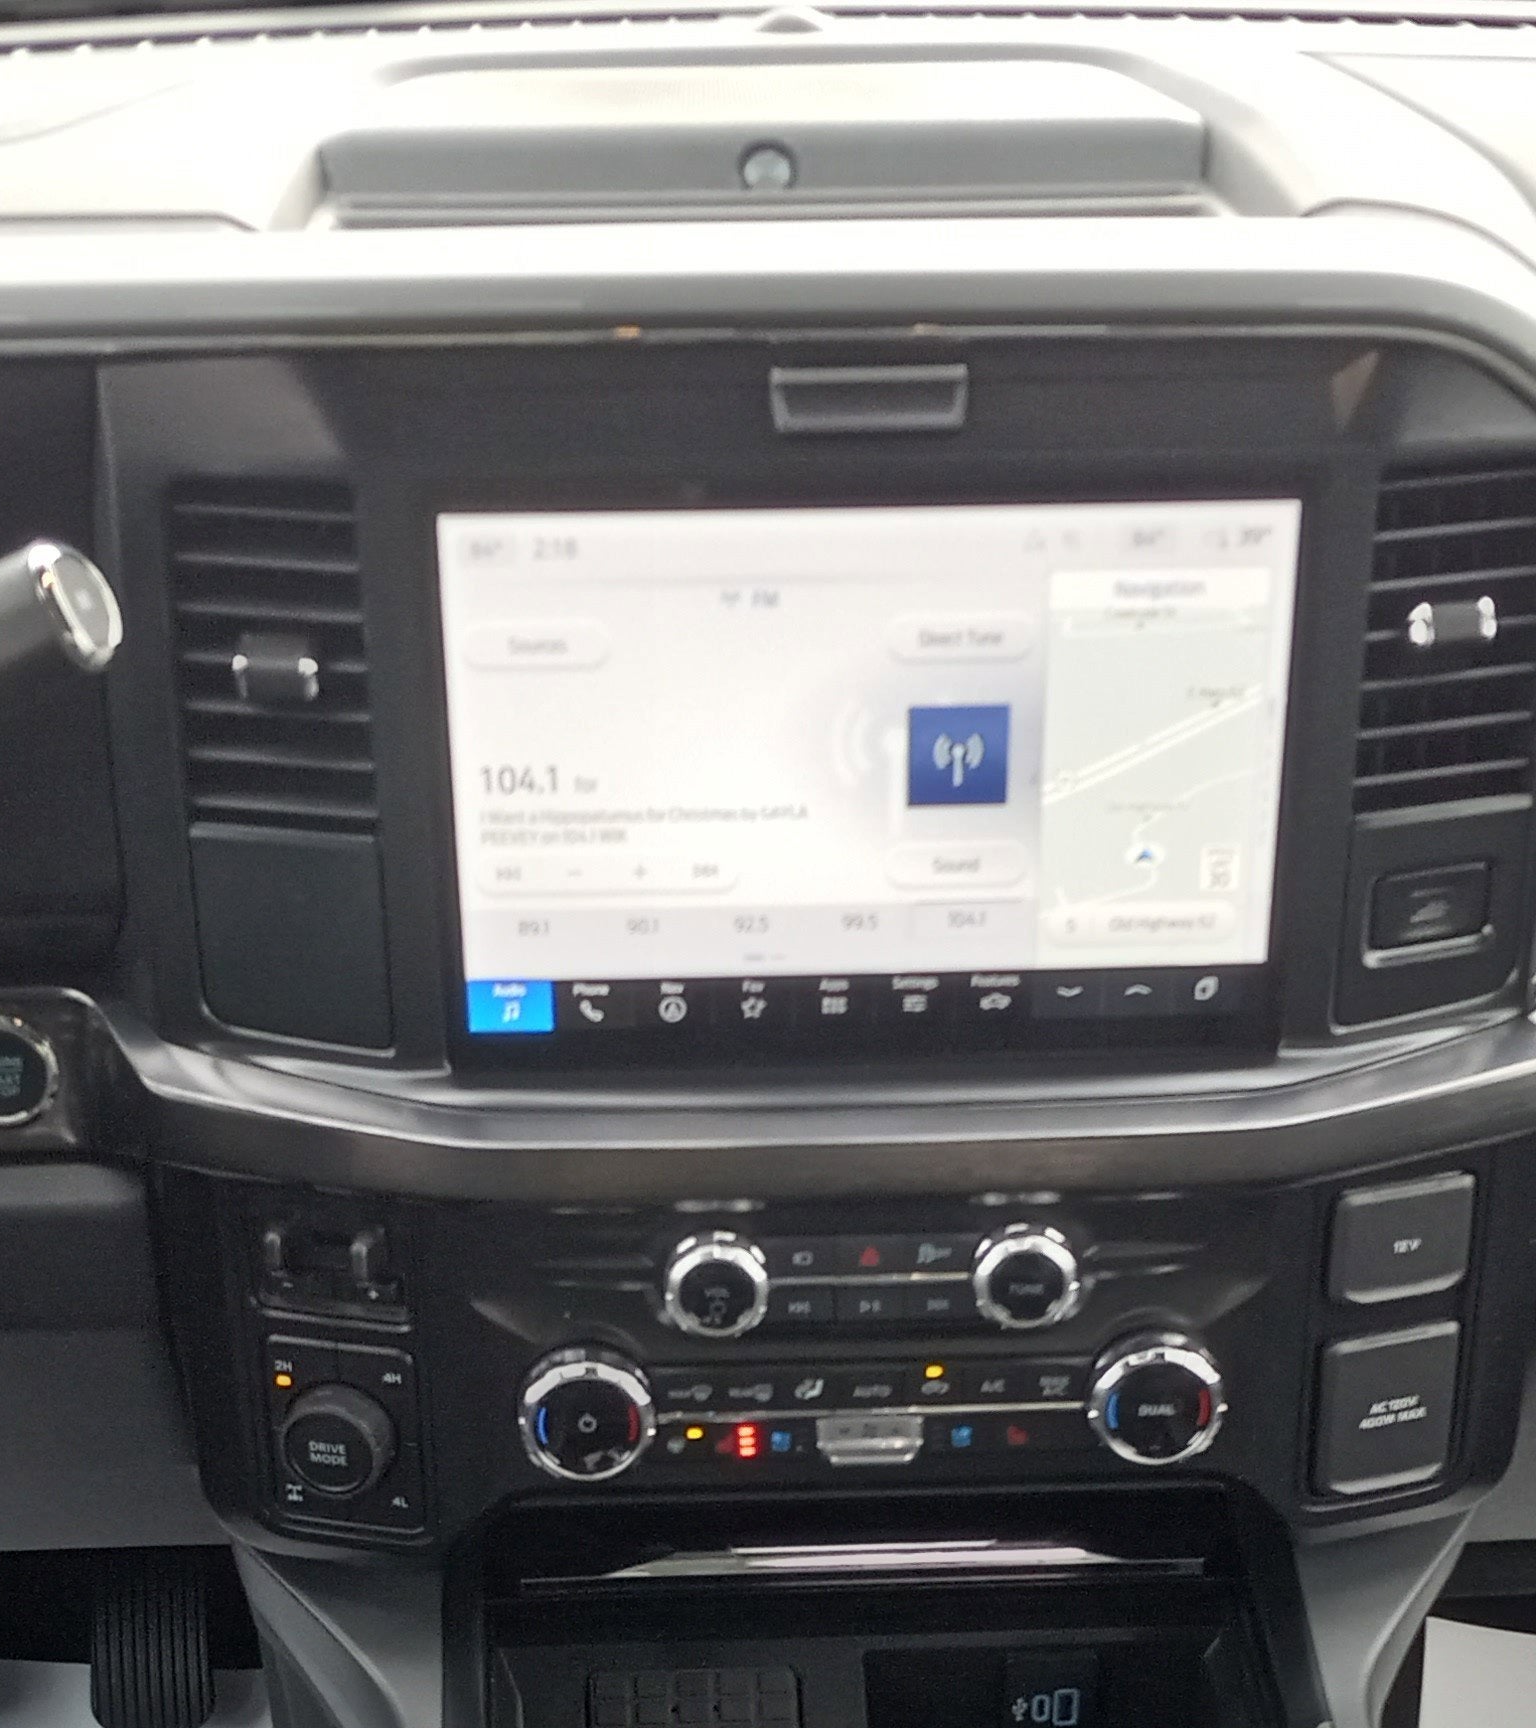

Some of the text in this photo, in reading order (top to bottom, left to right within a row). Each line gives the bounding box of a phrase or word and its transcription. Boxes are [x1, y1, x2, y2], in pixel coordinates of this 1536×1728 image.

[480, 764, 559, 796] 104.1
[275, 1359, 292, 1372] 2H
[382, 1372, 402, 1384] 4H
[1137, 1403, 1176, 1417] DUAL
[308, 1441, 346, 1455] DRIVE
[310, 1452, 347, 1466] MODE
[392, 1496, 409, 1508] 4L
